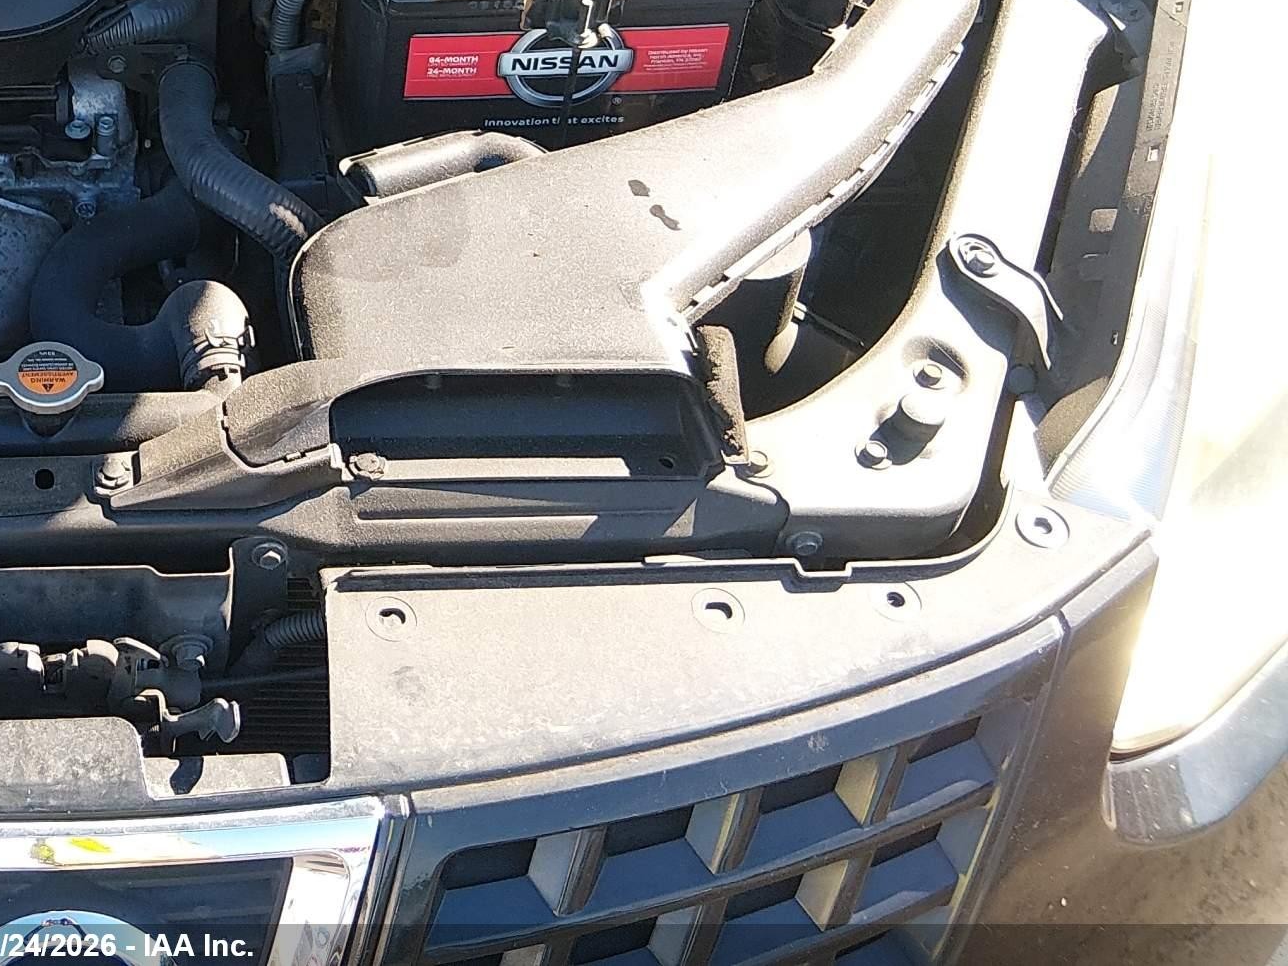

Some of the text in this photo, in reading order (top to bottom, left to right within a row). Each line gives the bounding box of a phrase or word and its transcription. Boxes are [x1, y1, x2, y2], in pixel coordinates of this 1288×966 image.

[511, 54, 619, 71] NISSAN
[426, 67, 478, 75] 24-MONTH
[484, 117, 550, 127] Innovation
[580, 114, 625, 124] excites
